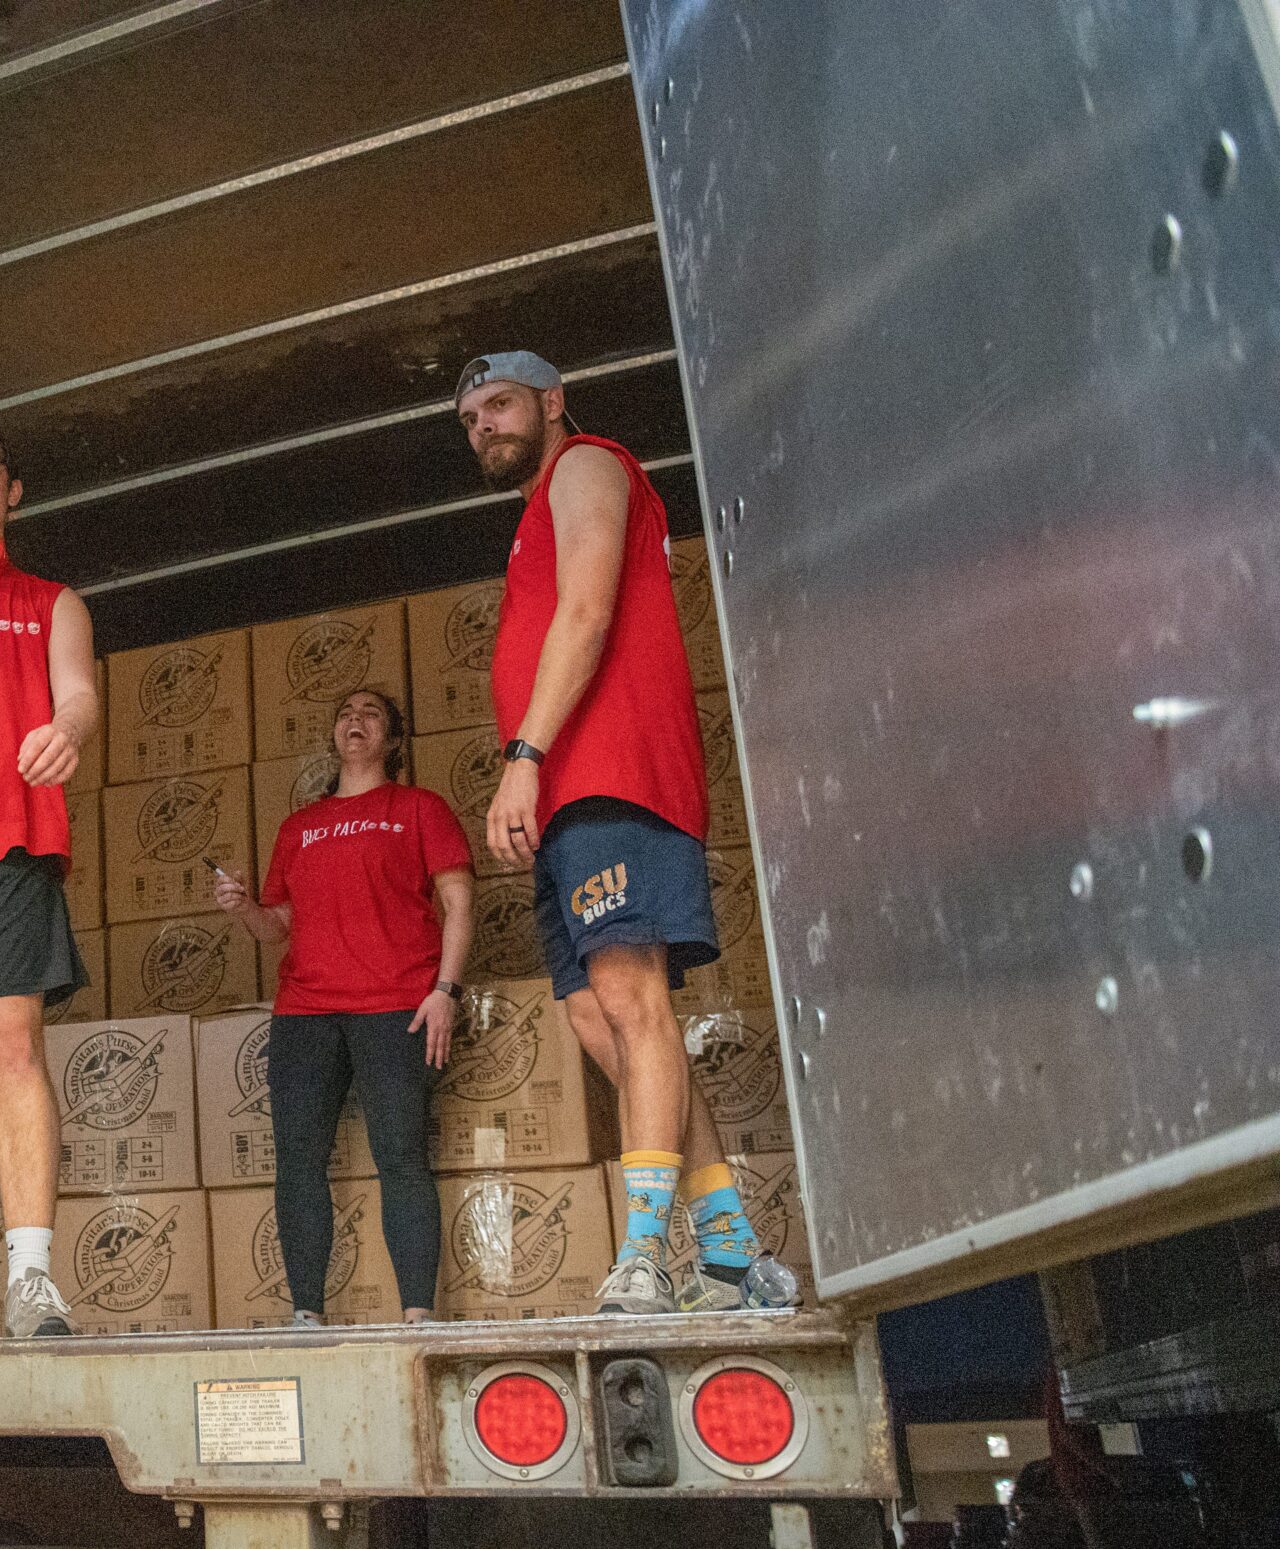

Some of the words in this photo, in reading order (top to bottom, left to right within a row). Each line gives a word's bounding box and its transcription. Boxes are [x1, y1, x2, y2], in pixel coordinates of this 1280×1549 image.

[302, 827, 329, 848] BUCS
[333, 819, 369, 837] PACK
[571, 862, 628, 916] CSU
[583, 890, 626, 925] BUCS
[70, 1039, 104, 1104] Samaritan's
[106, 1034, 137, 1053] Purse
[242, 1028, 271, 1092] Samaritan
[477, 1037, 530, 1081] OPERATION
[95, 1111, 137, 1126] Christmas
[135, 1088, 151, 1111] Child
[105, 1070, 151, 1111] OPERATION
[61, 1143, 72, 1162] BOY
[116, 1140, 128, 1160] GIRL
[236, 1134, 249, 1153] BOY
[81, 1214, 114, 1283] Samaritan's
[513, 1228, 558, 1275] PERATION
[542, 1250, 559, 1277] Child
[107, 1292, 150, 1308] Christmas
[149, 1268, 164, 1292] Child
[117, 1250, 164, 1291] OPERATION
